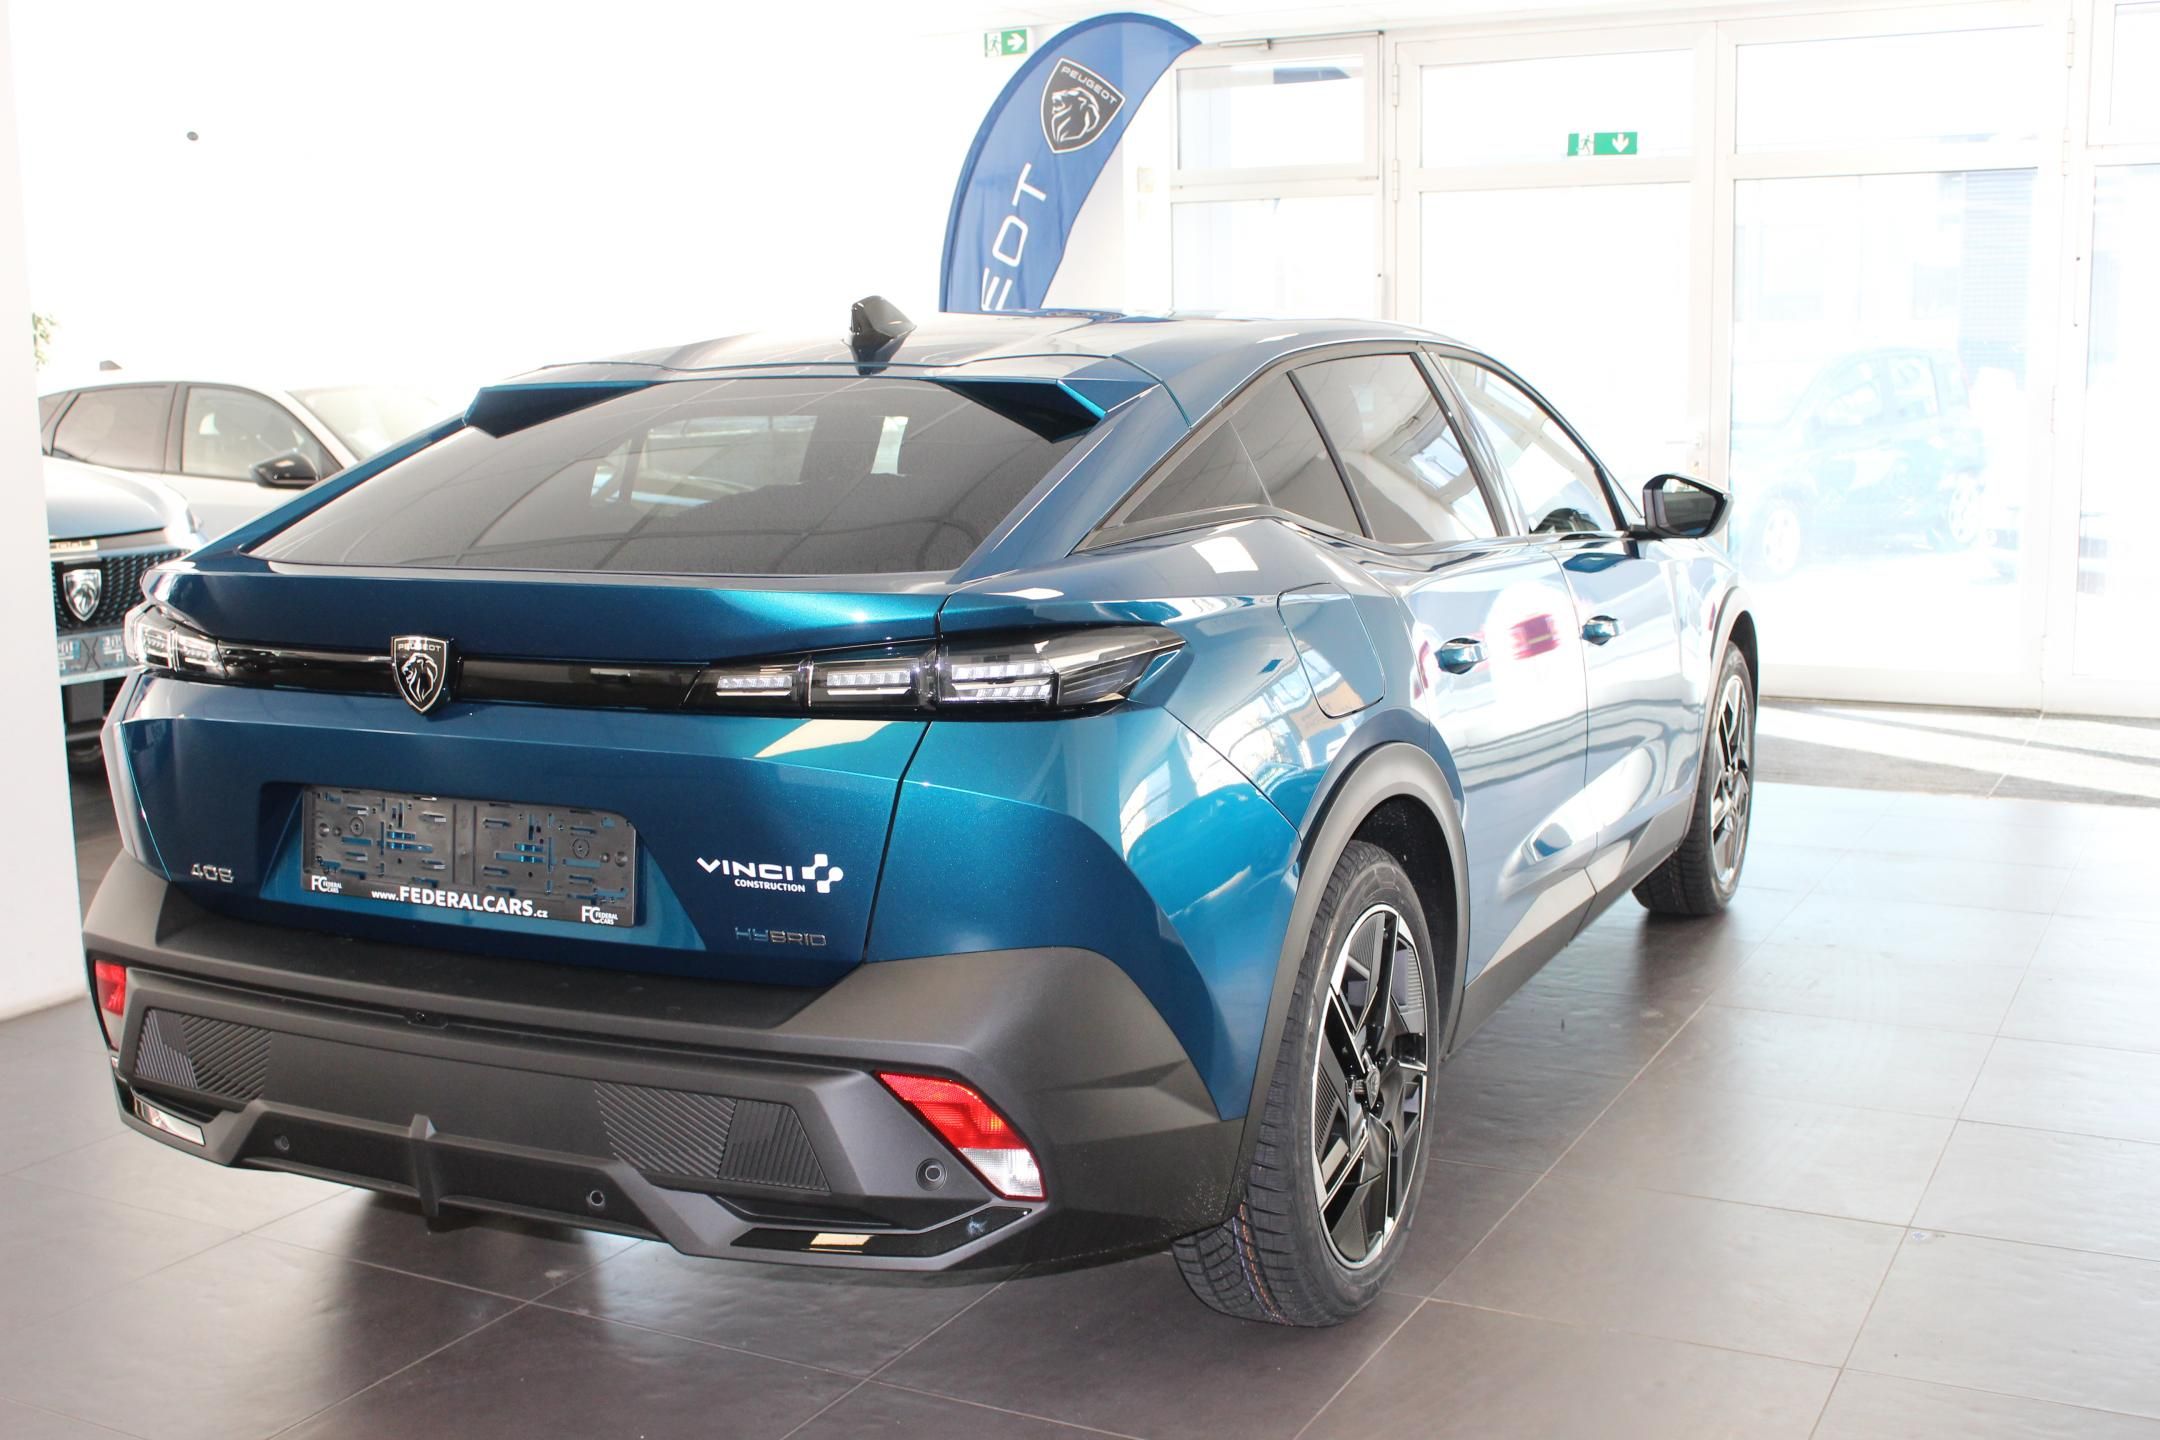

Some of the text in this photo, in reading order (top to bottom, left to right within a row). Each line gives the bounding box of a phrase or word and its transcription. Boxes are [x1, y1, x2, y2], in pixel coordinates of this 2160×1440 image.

[1061, 66, 1118, 105] PEUGEOT
[191, 863, 234, 883] 408
[697, 857, 794, 881] VINCI
[734, 878, 806, 893] CONSTRUCTION
[371, 886, 549, 918] www.FEDERALCARS.cz
[595, 911, 618, 920] FEDERAL
[734, 927, 827, 946] HYBRID
